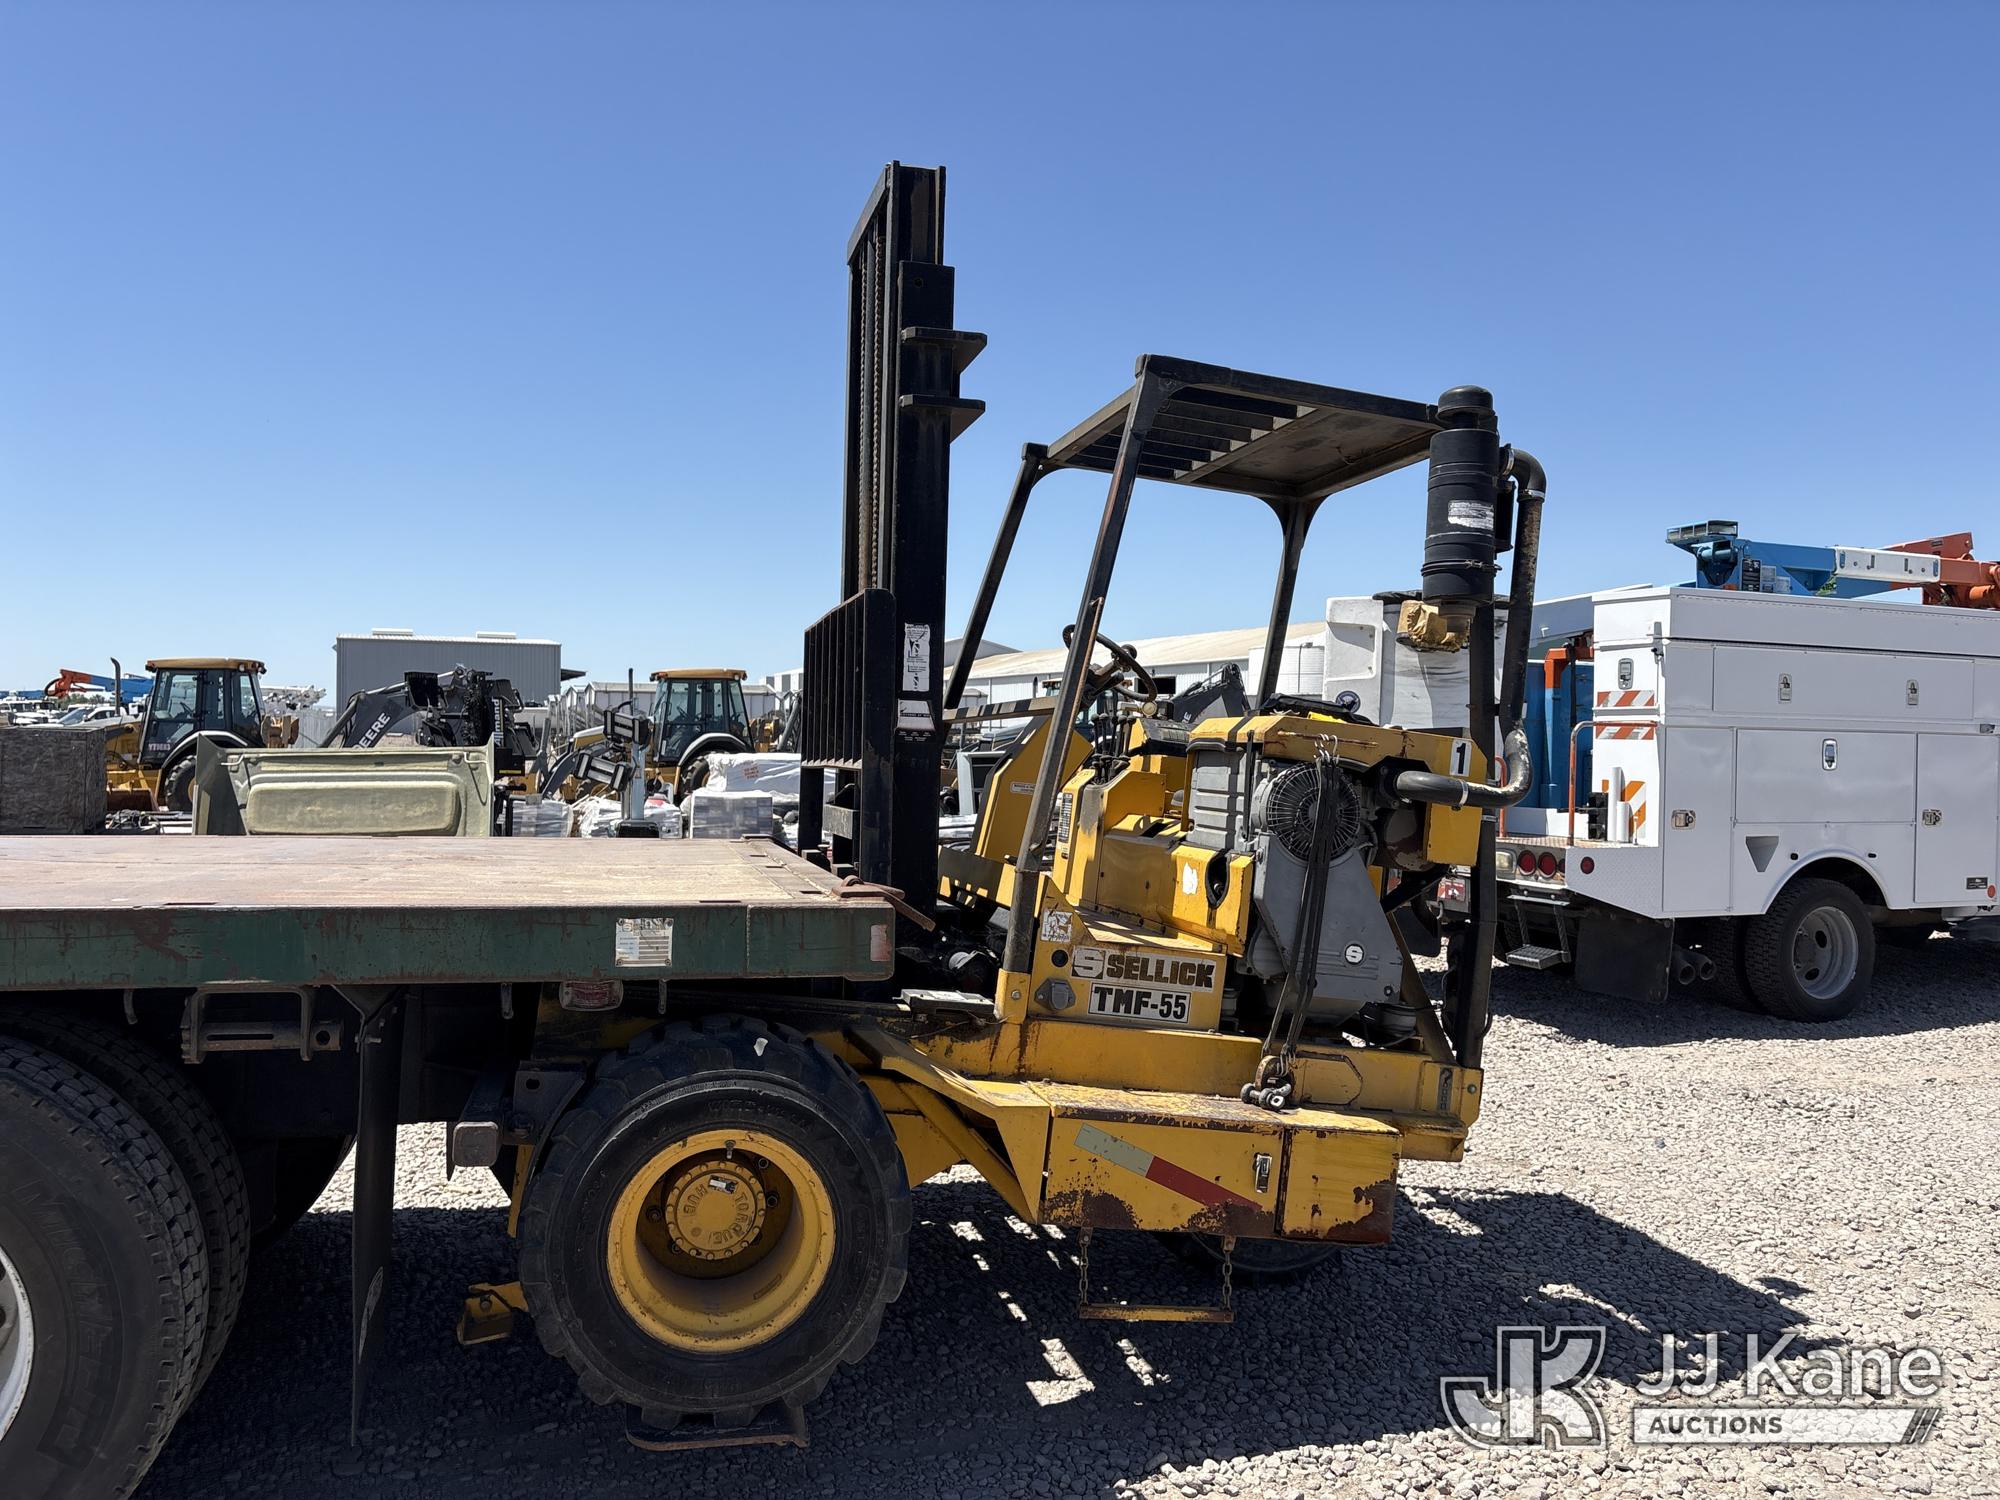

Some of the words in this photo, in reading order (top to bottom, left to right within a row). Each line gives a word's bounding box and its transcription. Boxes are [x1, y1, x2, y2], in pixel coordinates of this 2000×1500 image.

[492, 696, 504, 747] Allmand
[1456, 742, 1467, 775] 1
[1106, 953, 1216, 988] SELLICK
[1093, 986, 1187, 1020] TMF-55
